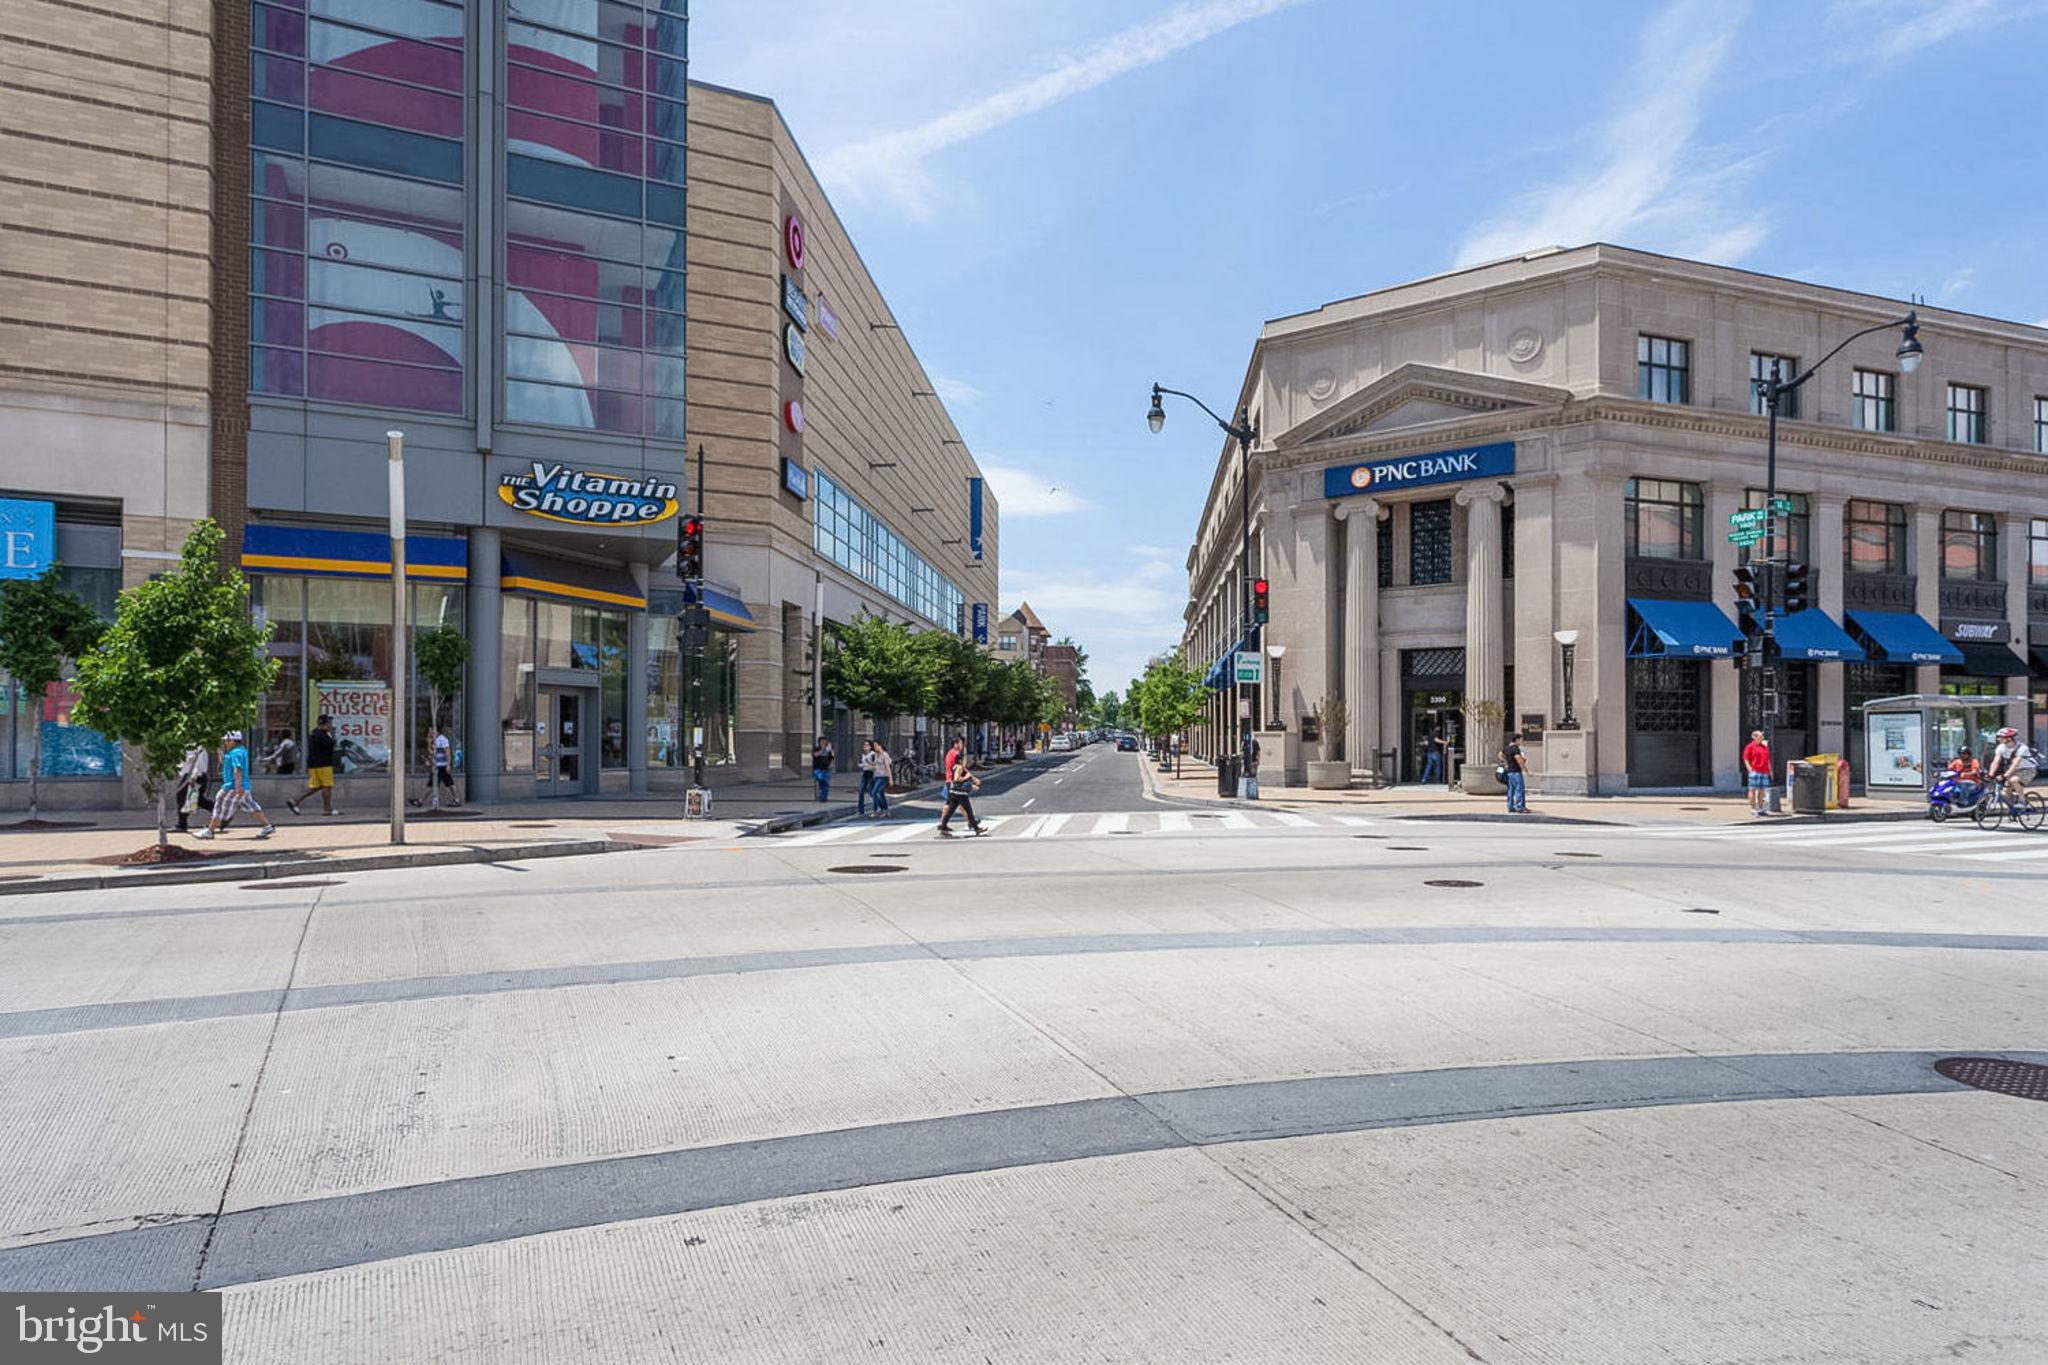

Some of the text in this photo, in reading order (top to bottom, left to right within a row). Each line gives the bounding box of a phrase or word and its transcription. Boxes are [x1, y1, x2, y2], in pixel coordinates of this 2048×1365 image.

[502, 462, 677, 499] THE Vitamin
[512, 488, 659, 520] Shoppe
[1955, 623, 1998, 639] SUBWAY
[320, 688, 392, 704] xtreme
[320, 702, 391, 716] muscle
[341, 719, 384, 737] sale
